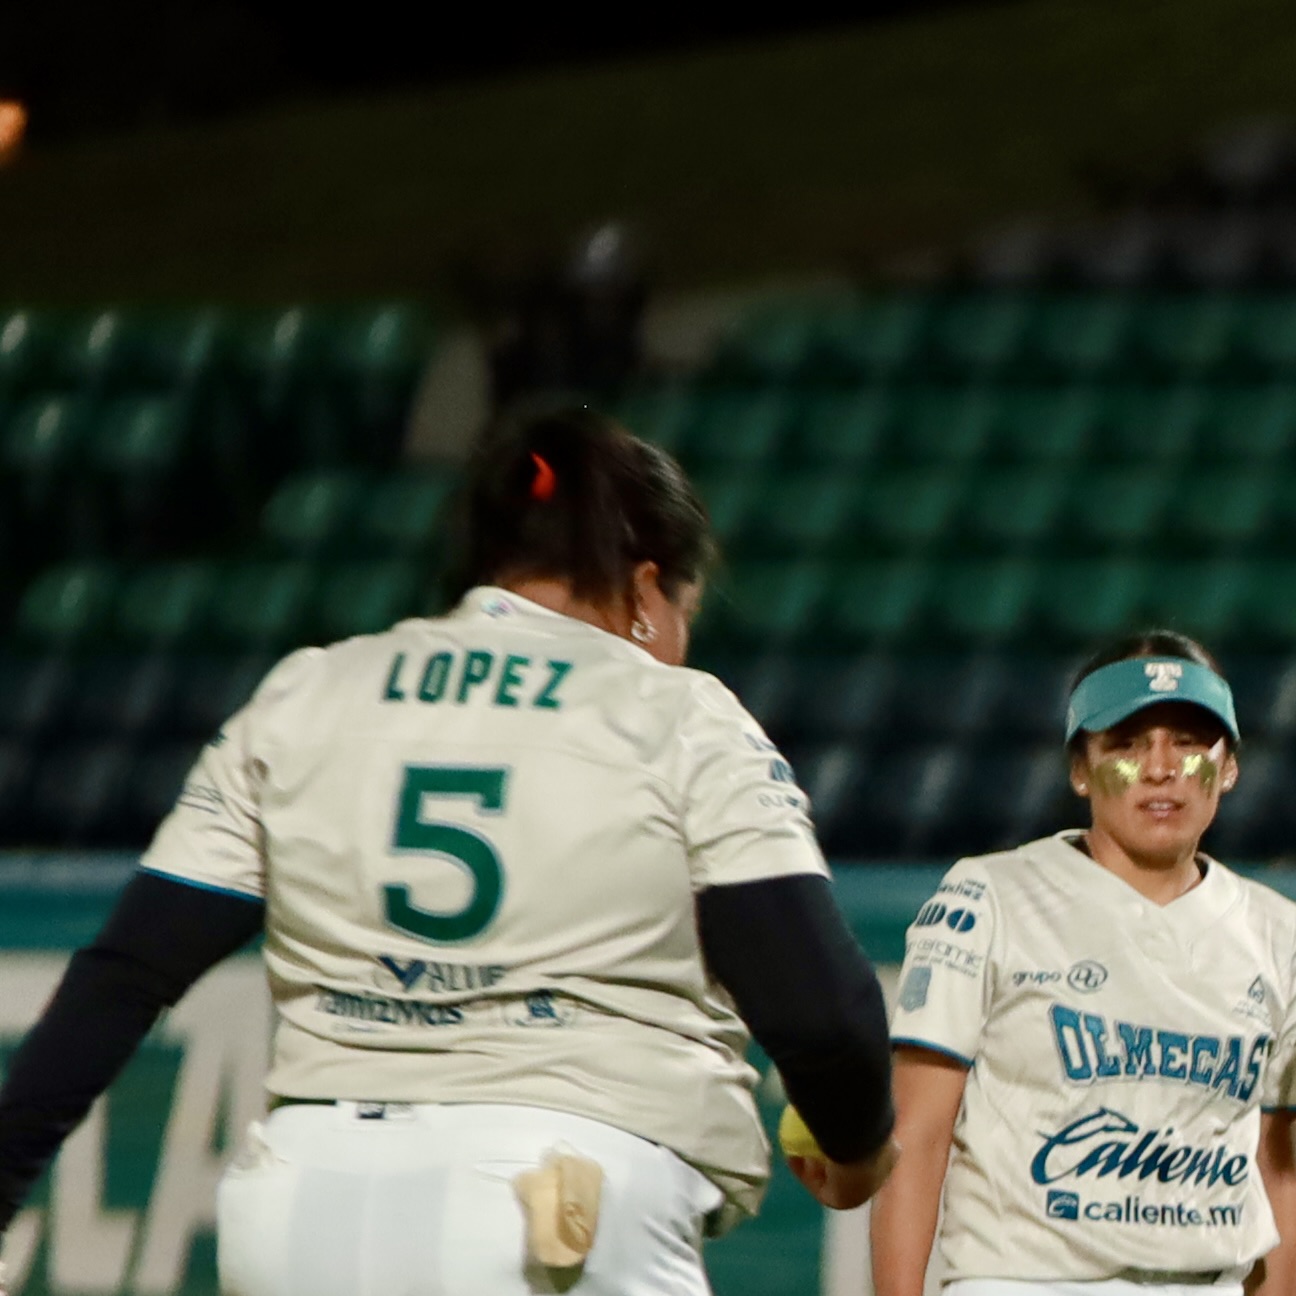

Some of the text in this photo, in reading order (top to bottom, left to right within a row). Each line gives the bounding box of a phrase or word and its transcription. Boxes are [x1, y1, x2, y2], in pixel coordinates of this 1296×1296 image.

[383, 649, 575, 710] LOPEZ
[380, 762, 510, 947] 5
[1012, 969, 1062, 986] grupo
[1049, 1003, 1270, 1102] OLMECAS
[1031, 1106, 1249, 1188] Caliente
